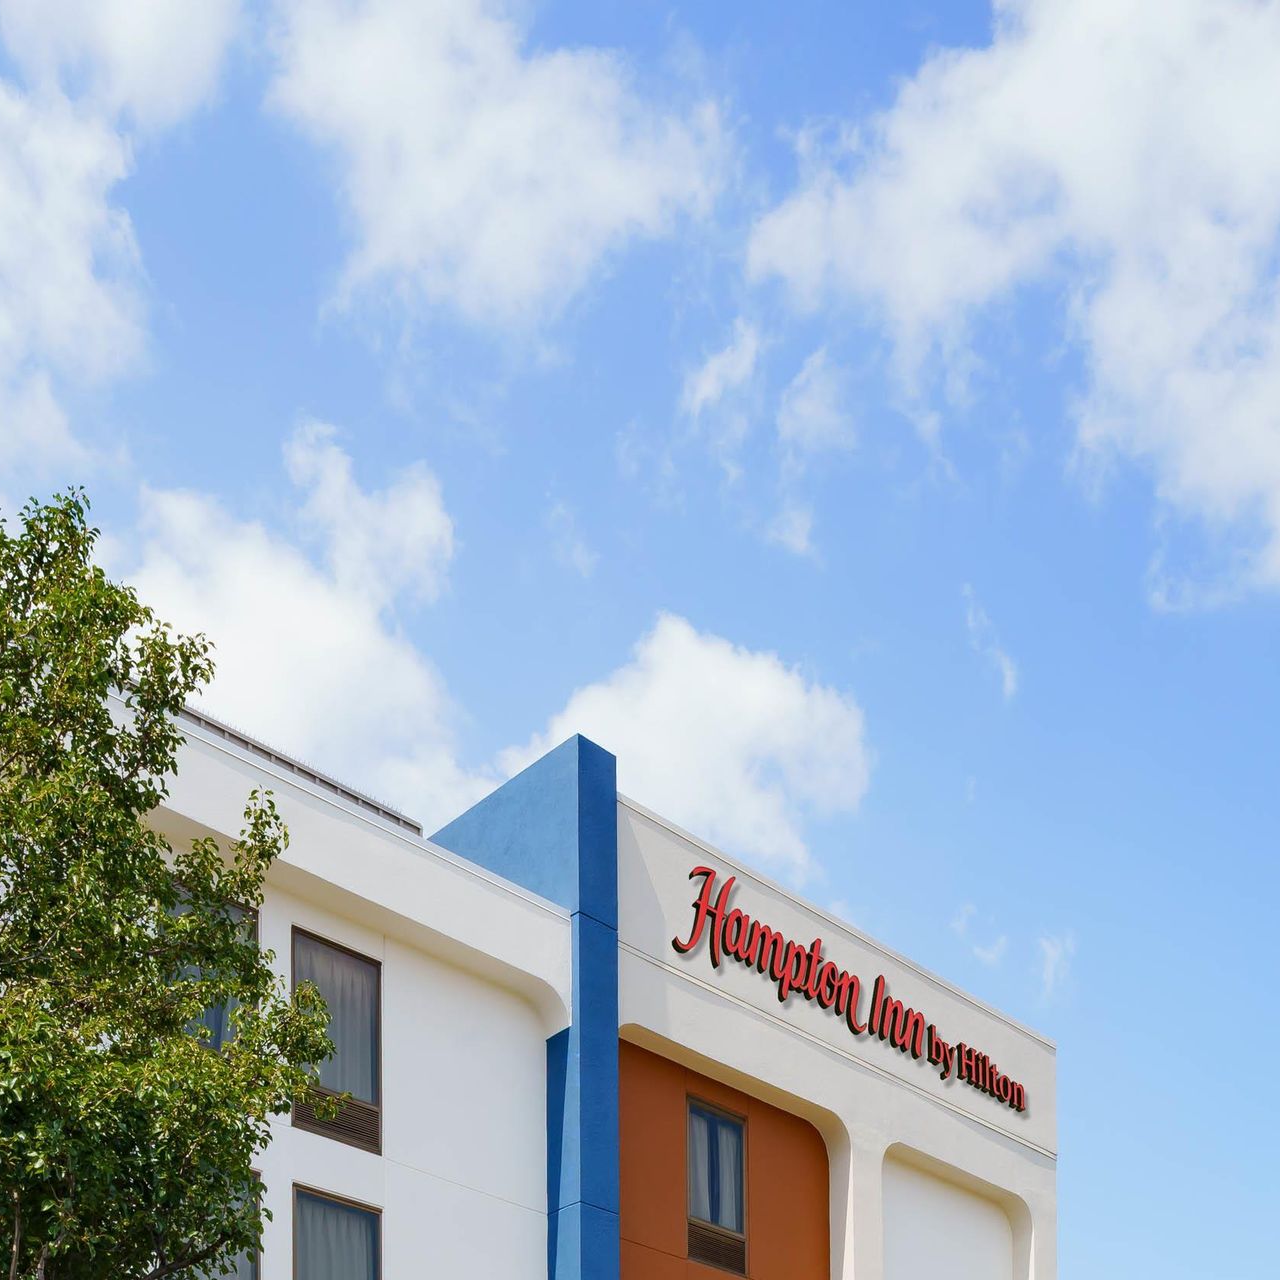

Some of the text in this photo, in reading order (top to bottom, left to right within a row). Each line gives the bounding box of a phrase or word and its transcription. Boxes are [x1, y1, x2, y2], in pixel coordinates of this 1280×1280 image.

[672, 866, 1025, 1112] Hampton Inn by Hilton
